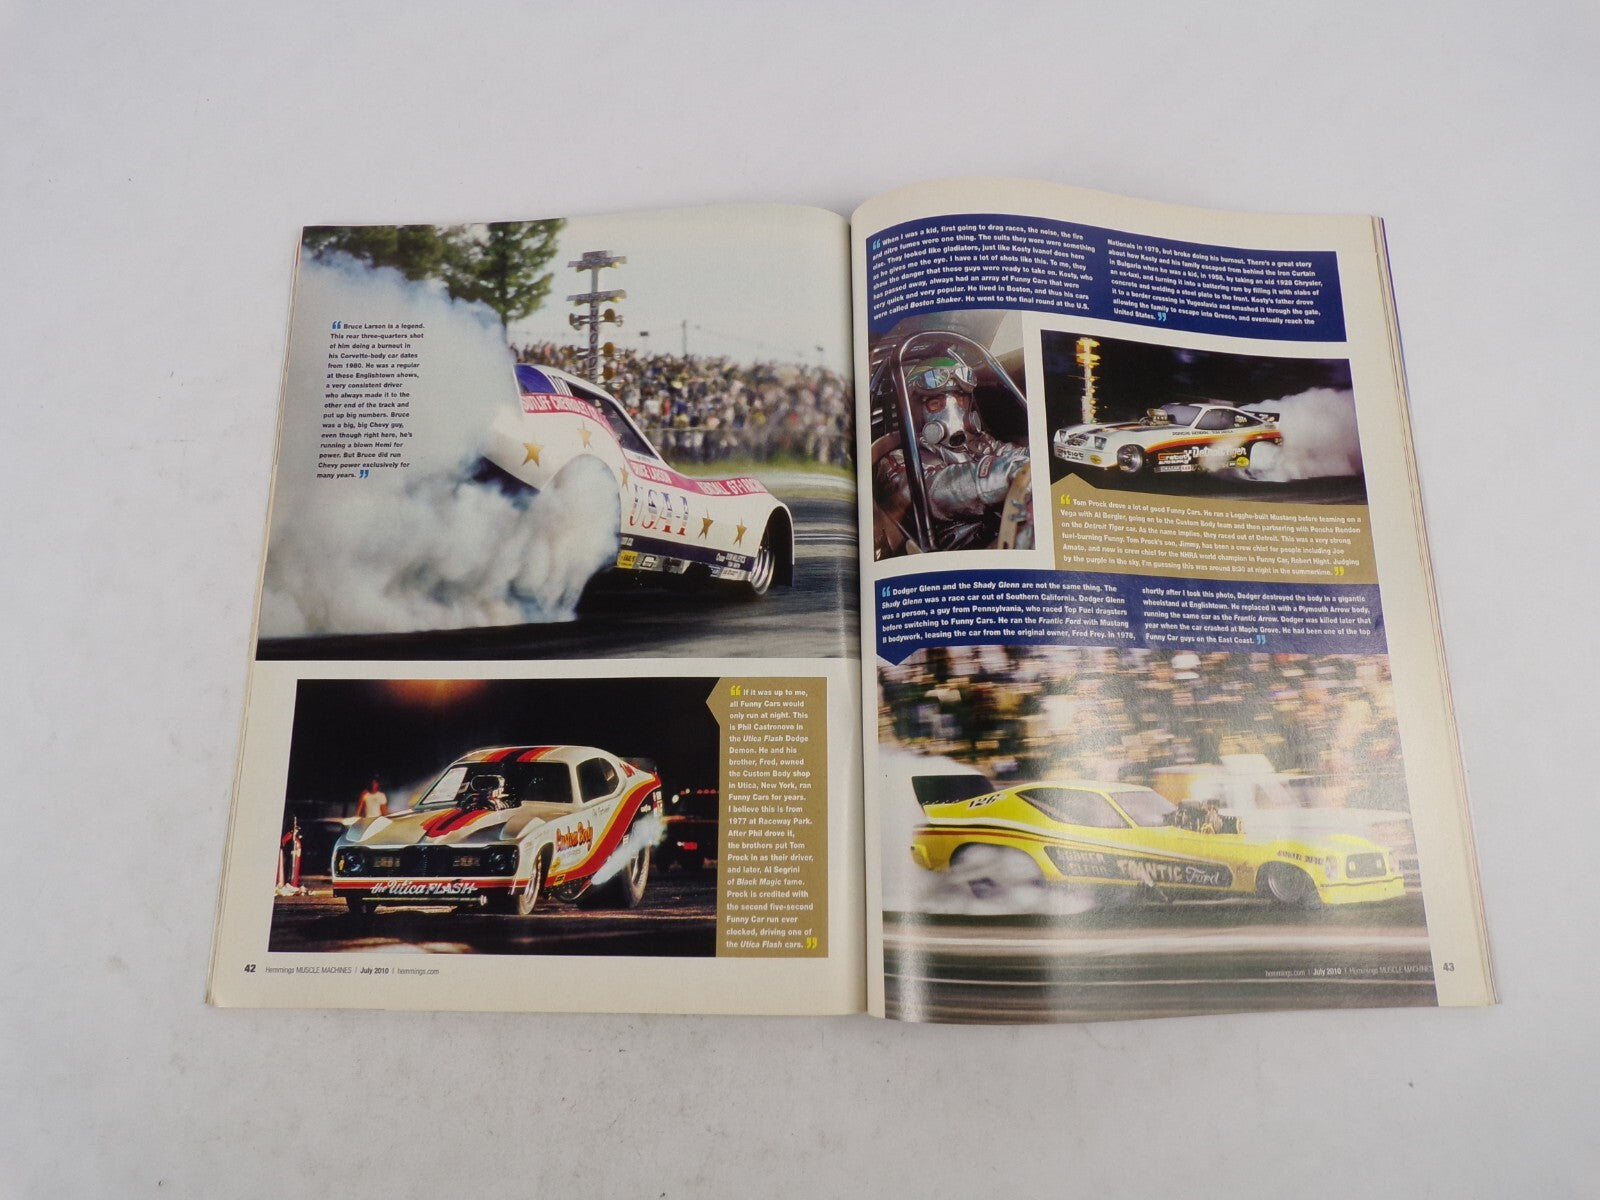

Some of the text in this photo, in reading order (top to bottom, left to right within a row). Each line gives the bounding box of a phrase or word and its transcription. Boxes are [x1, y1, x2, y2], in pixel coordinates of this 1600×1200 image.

[1108, 249, 1126, 257] about
[1126, 251, 1140, 260] how
[1140, 254, 1158, 264] Kosty
[1181, 260, 1200, 270] family
[873, 310, 888, 320] were
[889, 303, 909, 314] called
[910, 299, 934, 309] Boston
[936, 296, 964, 304] Shaker.
[1076, 302, 1090, 310] U.S.
[901, 609, 928, 619] person,
[936, 608, 951, 616] guy
[972, 604, 1024, 613] Pennsylvania,
[1064, 605, 1077, 615] Top
[1095, 607, 1128, 616] dragsters
[1143, 610, 1169, 619] running
[1233, 614, 1256, 622] Frantic
[1280, 616, 1304, 625] Dodger
[882, 623, 903, 632] before
[904, 619, 939, 629] switching
[950, 617, 974, 626] Funny
[1038, 616, 1064, 625] Frantic
[1083, 618, 1098, 626] with
[1100, 618, 1129, 629] Mustang
[1145, 633, 1166, 643] Funny
[1233, 636, 1255, 644] Coast.
[729, 712, 745, 720] only
[769, 711, 791, 720] night.
[785, 734, 809, 743] Dodge
[737, 782, 759, 790] Utica,
[778, 781, 797, 790] York,
[729, 817, 747, 825] 1977
[758, 817, 791, 826] Raceway
[1186, 866, 1220, 884] Ford
[424, 882, 478, 894] FLASH
[726, 890, 748, 898] Prock
[759, 890, 790, 898] credited
[792, 890, 809, 898] with
[244, 964, 256, 973] 42
[360, 967, 373, 976] July
[1313, 967, 1342, 977] July 2010
[1443, 962, 1455, 972] 43
